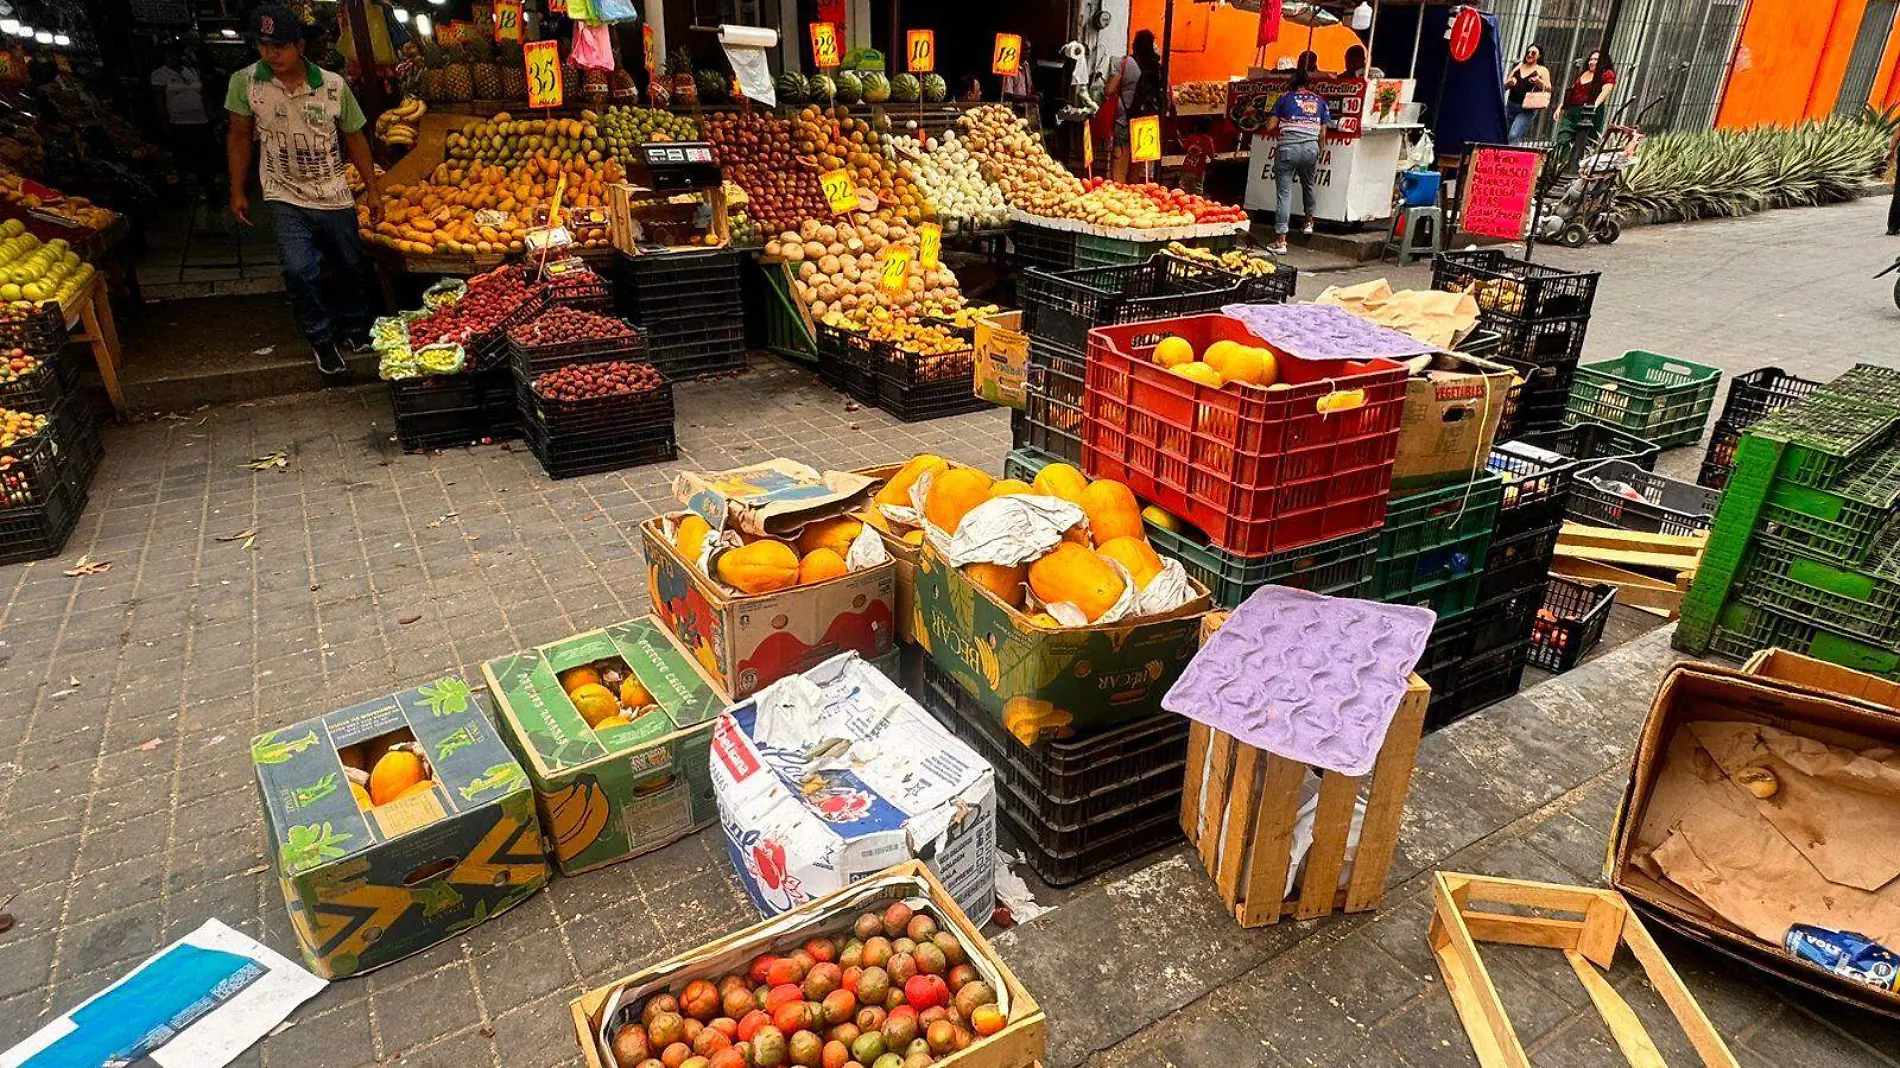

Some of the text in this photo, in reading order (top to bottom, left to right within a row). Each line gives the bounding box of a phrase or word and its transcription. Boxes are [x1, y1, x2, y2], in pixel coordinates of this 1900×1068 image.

[501, 10, 517, 28] 18
[910, 40, 930, 63] 10
[997, 46, 1016, 63] 18
[529, 58, 556, 95] 35
[826, 181, 852, 203] 22
